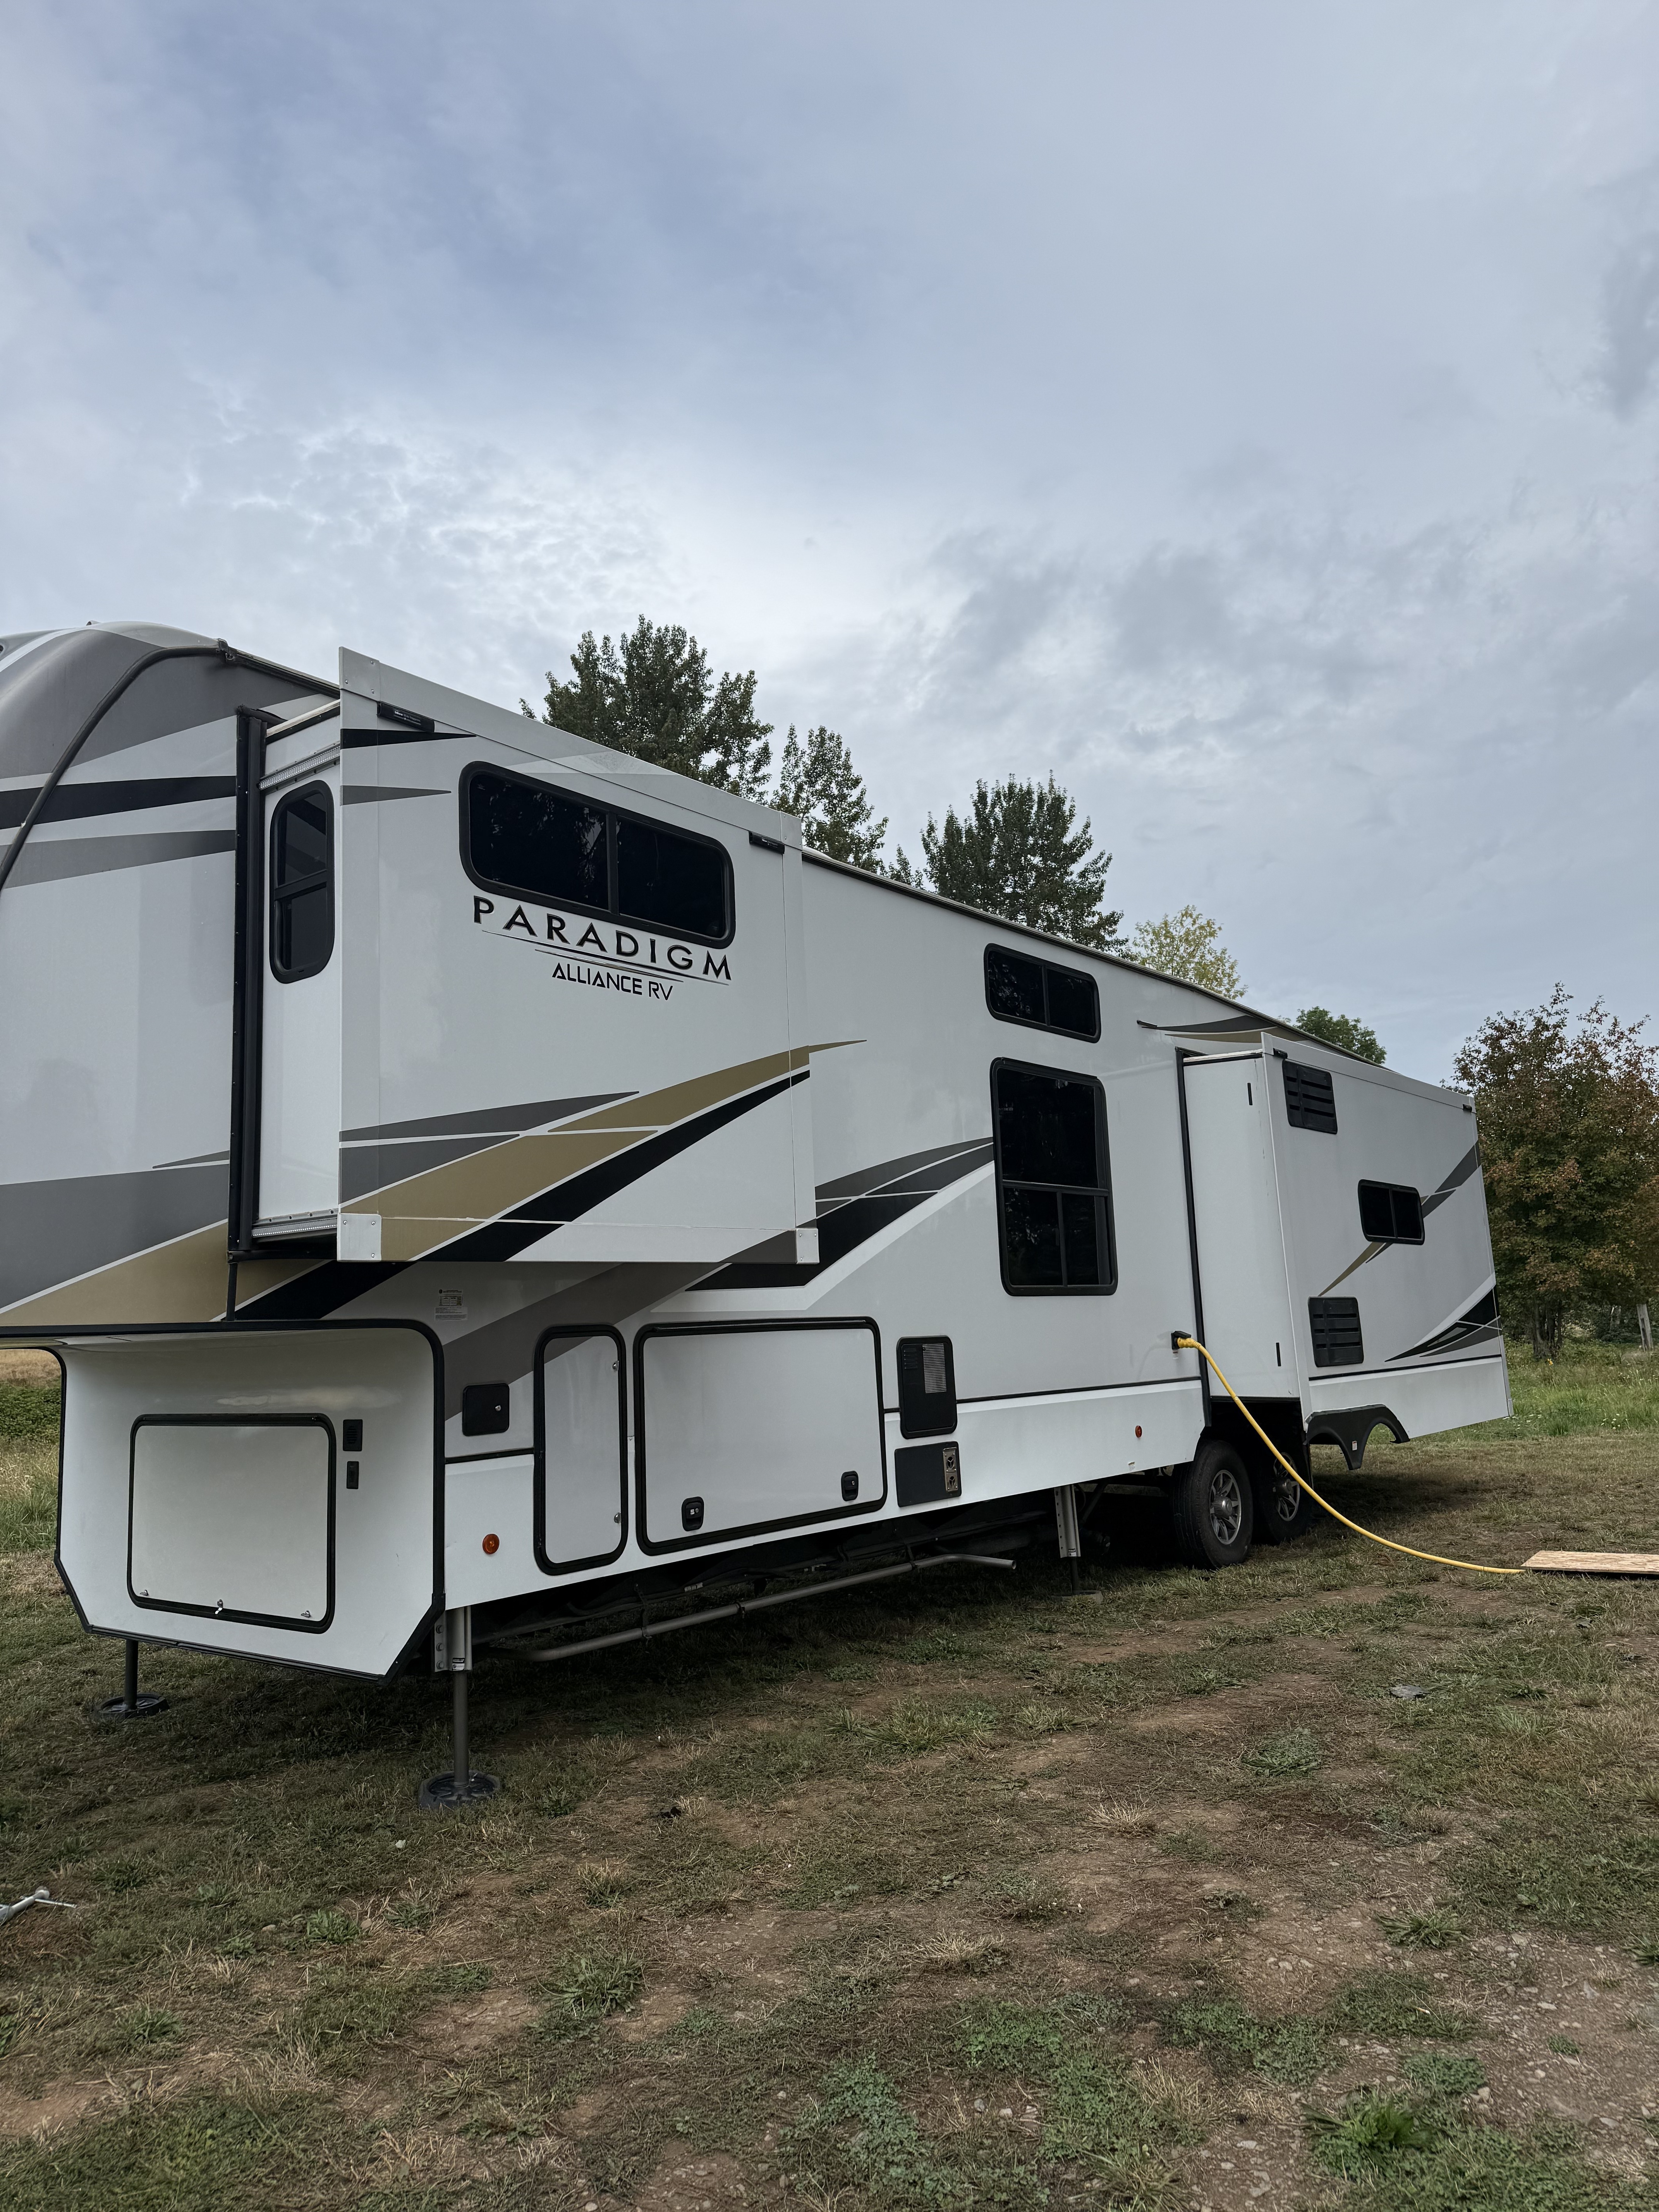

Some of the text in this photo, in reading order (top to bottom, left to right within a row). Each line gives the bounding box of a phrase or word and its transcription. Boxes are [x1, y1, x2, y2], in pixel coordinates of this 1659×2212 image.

[473, 895, 732, 981] PARADIGM
[552, 962, 673, 1001] ALLIANCE RV
